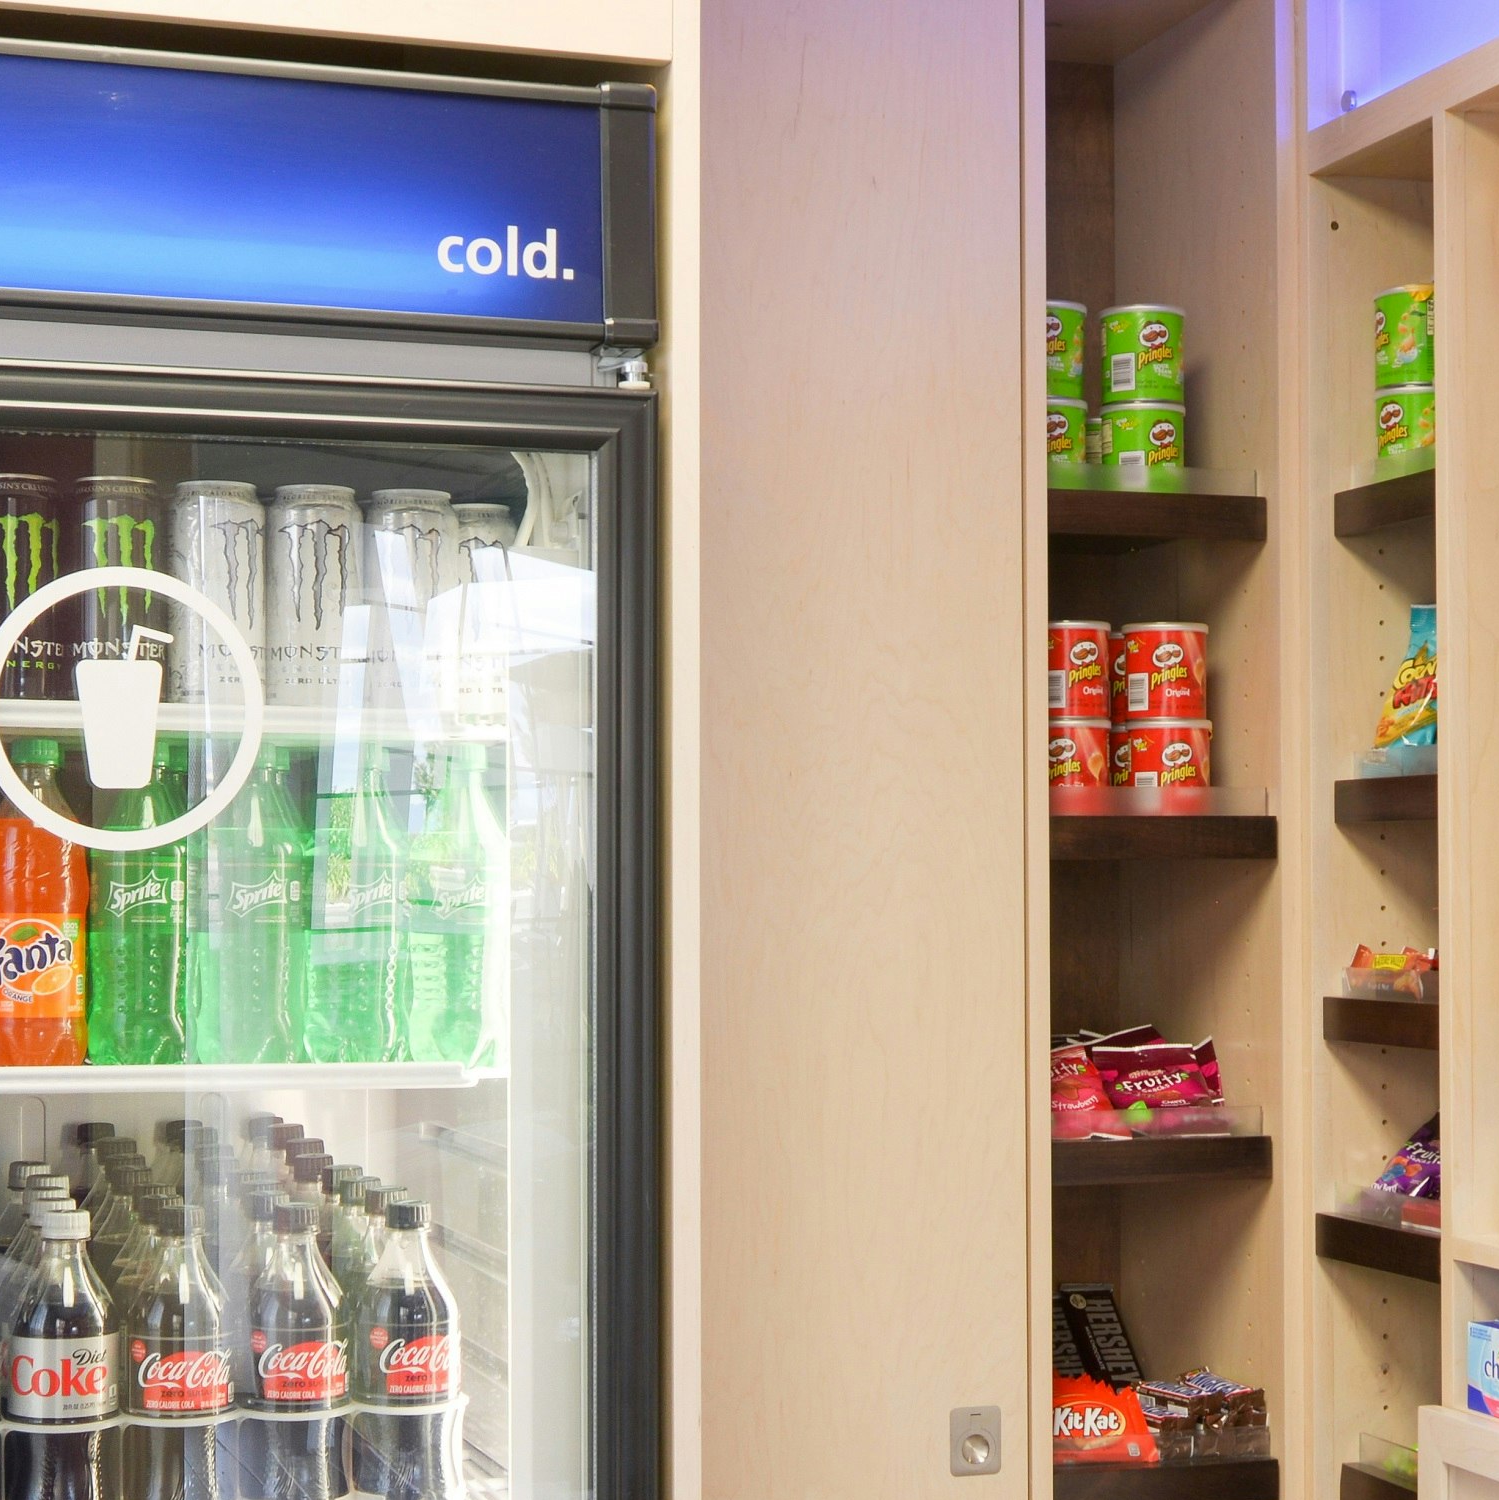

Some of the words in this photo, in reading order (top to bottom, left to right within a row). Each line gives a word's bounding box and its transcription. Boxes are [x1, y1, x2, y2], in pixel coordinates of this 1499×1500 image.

[438, 225, 576, 279] cold.
[1138, 344, 1174, 370] Pringles
[111, 880, 163, 914] Sprite
[232, 881, 284, 914] Sprite
[1, 987, 33, 1003] ORANGE
[1121, 1069, 1184, 1093] Fruity
[72, 1348, 107, 1367] Diet
[137, 1347, 232, 1389] Coca-Cola
[258, 1337, 349, 1384] Coca-Cola
[11, 1353, 108, 1398] Coke
[160, 1400, 182, 1409] CALORIE
[280, 1389, 302, 1399] CALORIE
